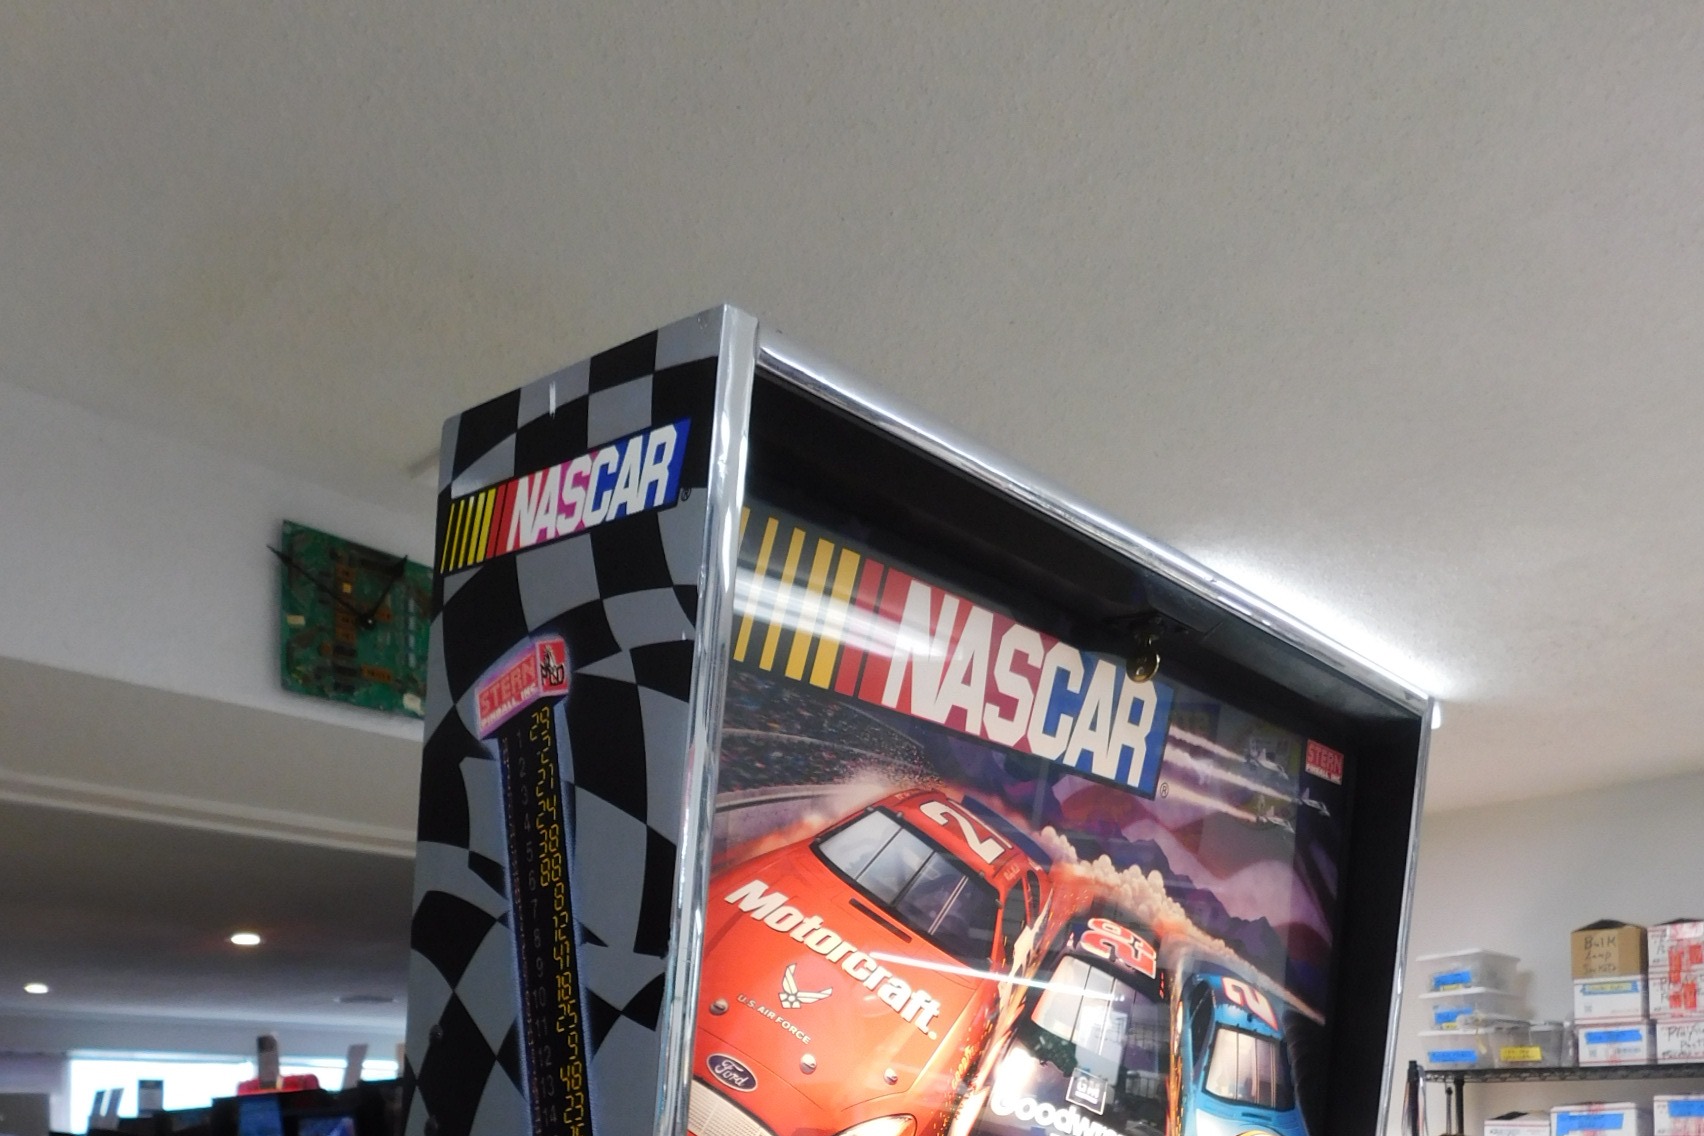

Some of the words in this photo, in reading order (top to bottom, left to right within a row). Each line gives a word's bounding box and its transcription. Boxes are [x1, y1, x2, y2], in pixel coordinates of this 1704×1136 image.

[506, 424, 677, 553] NASCAR
[479, 653, 537, 713] STERN
[882, 579, 1158, 789] NASCAR
[737, 994, 757, 1009] U.S.
[757, 1005, 776, 1020] AIR
[775, 1016, 811, 1045] FORCE
[1222, 976, 1279, 1032] 2
[714, 1059, 750, 1088] Ford
[1077, 1076, 1100, 1099] GM
